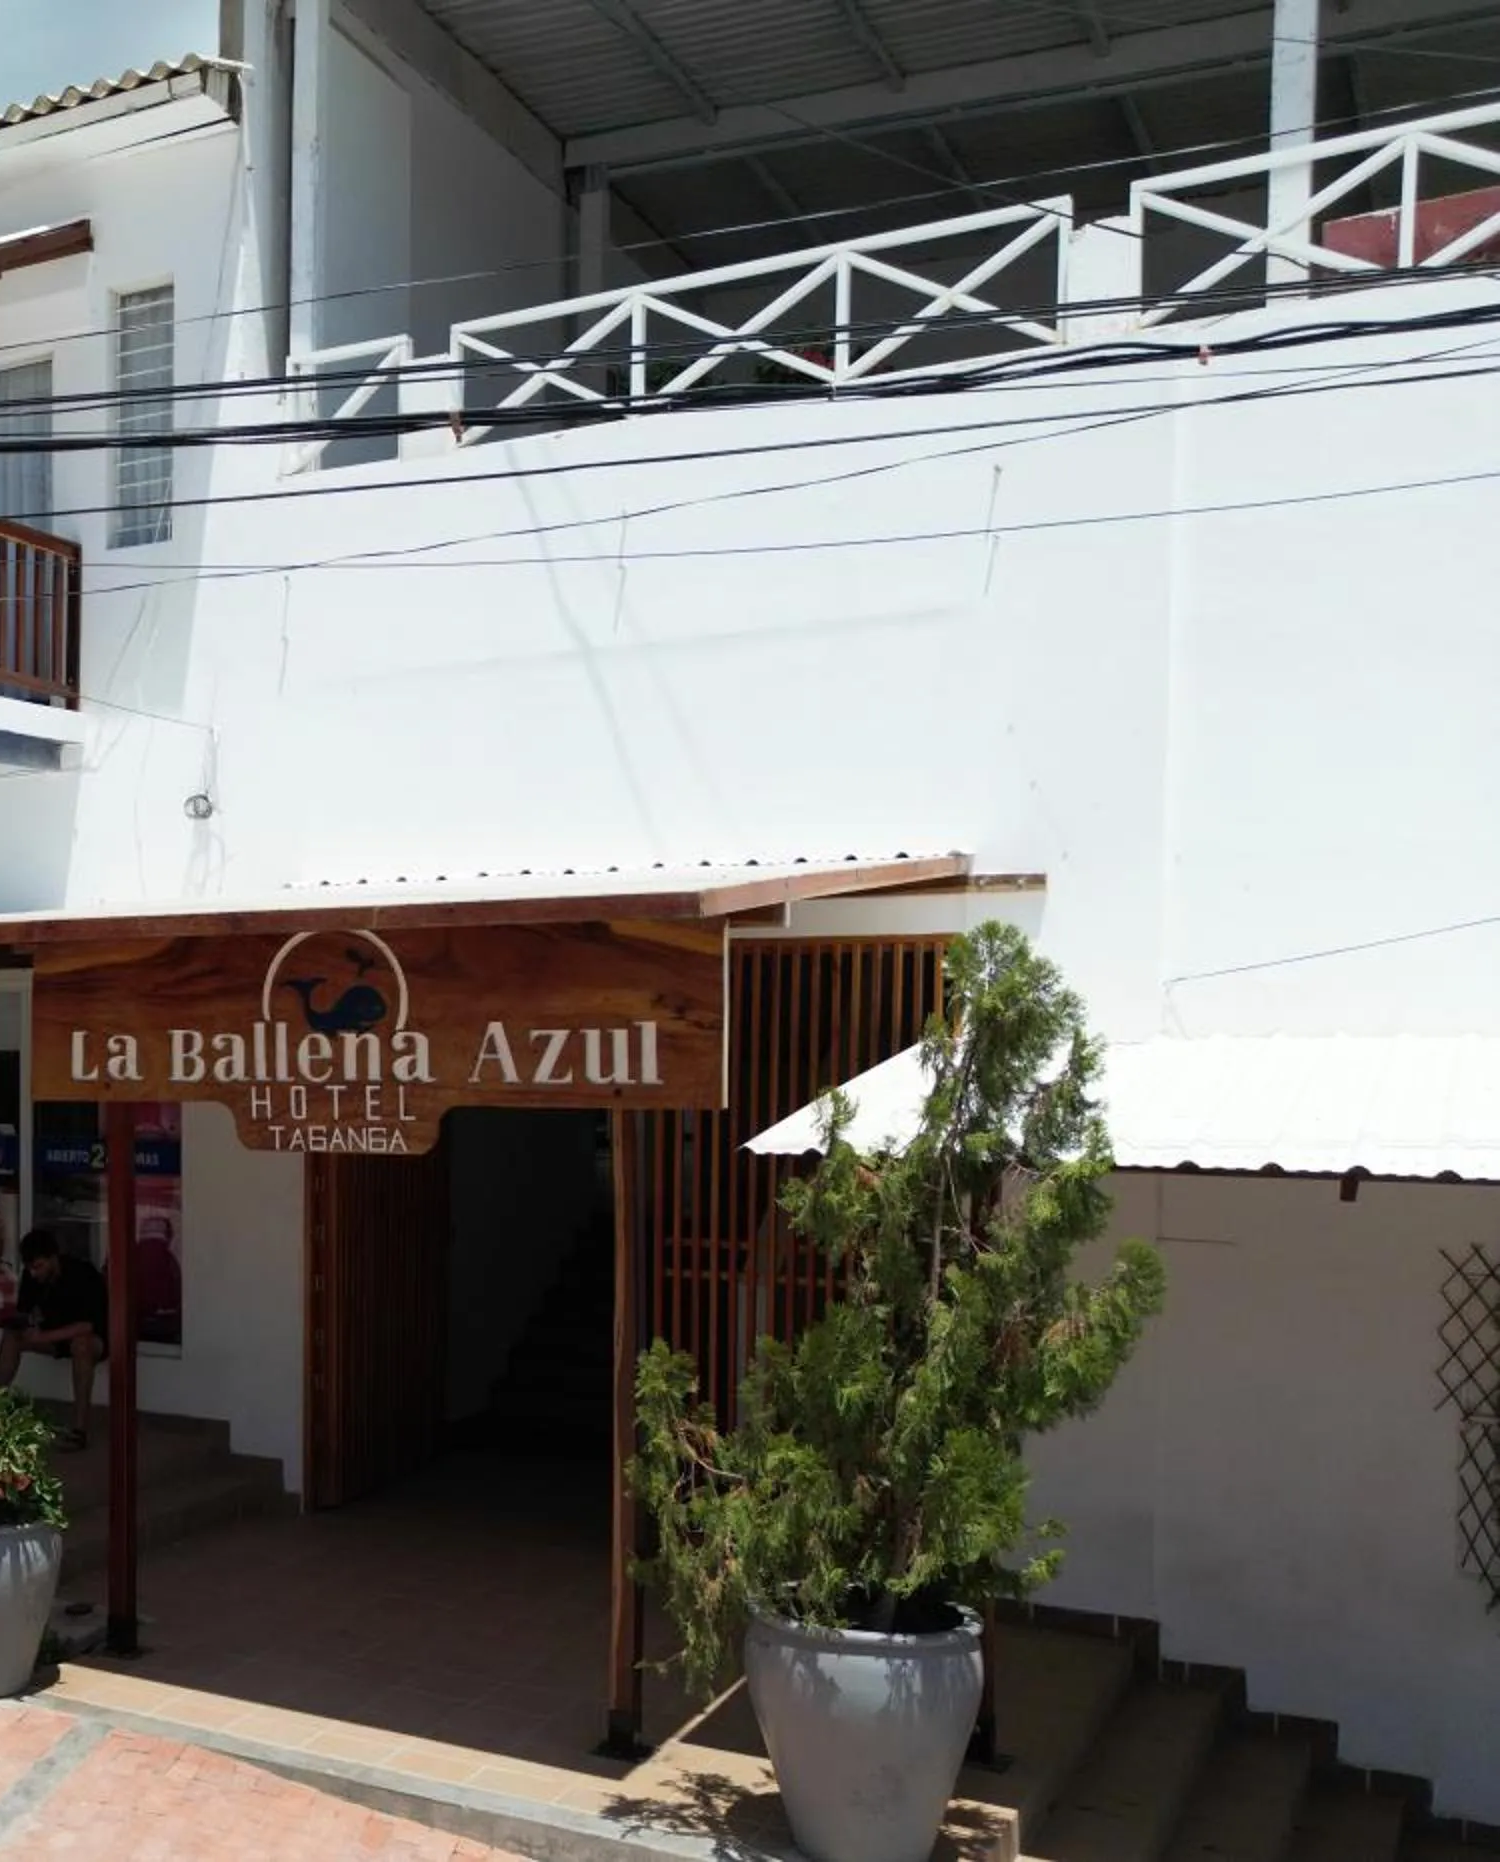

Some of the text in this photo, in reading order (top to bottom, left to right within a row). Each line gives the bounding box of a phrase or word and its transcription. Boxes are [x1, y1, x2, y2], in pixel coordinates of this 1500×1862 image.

[71, 1021, 664, 1085] La Ballena Azul
[251, 1085, 416, 1121] HOTEL
[268, 1125, 408, 1152] TAGANGA
